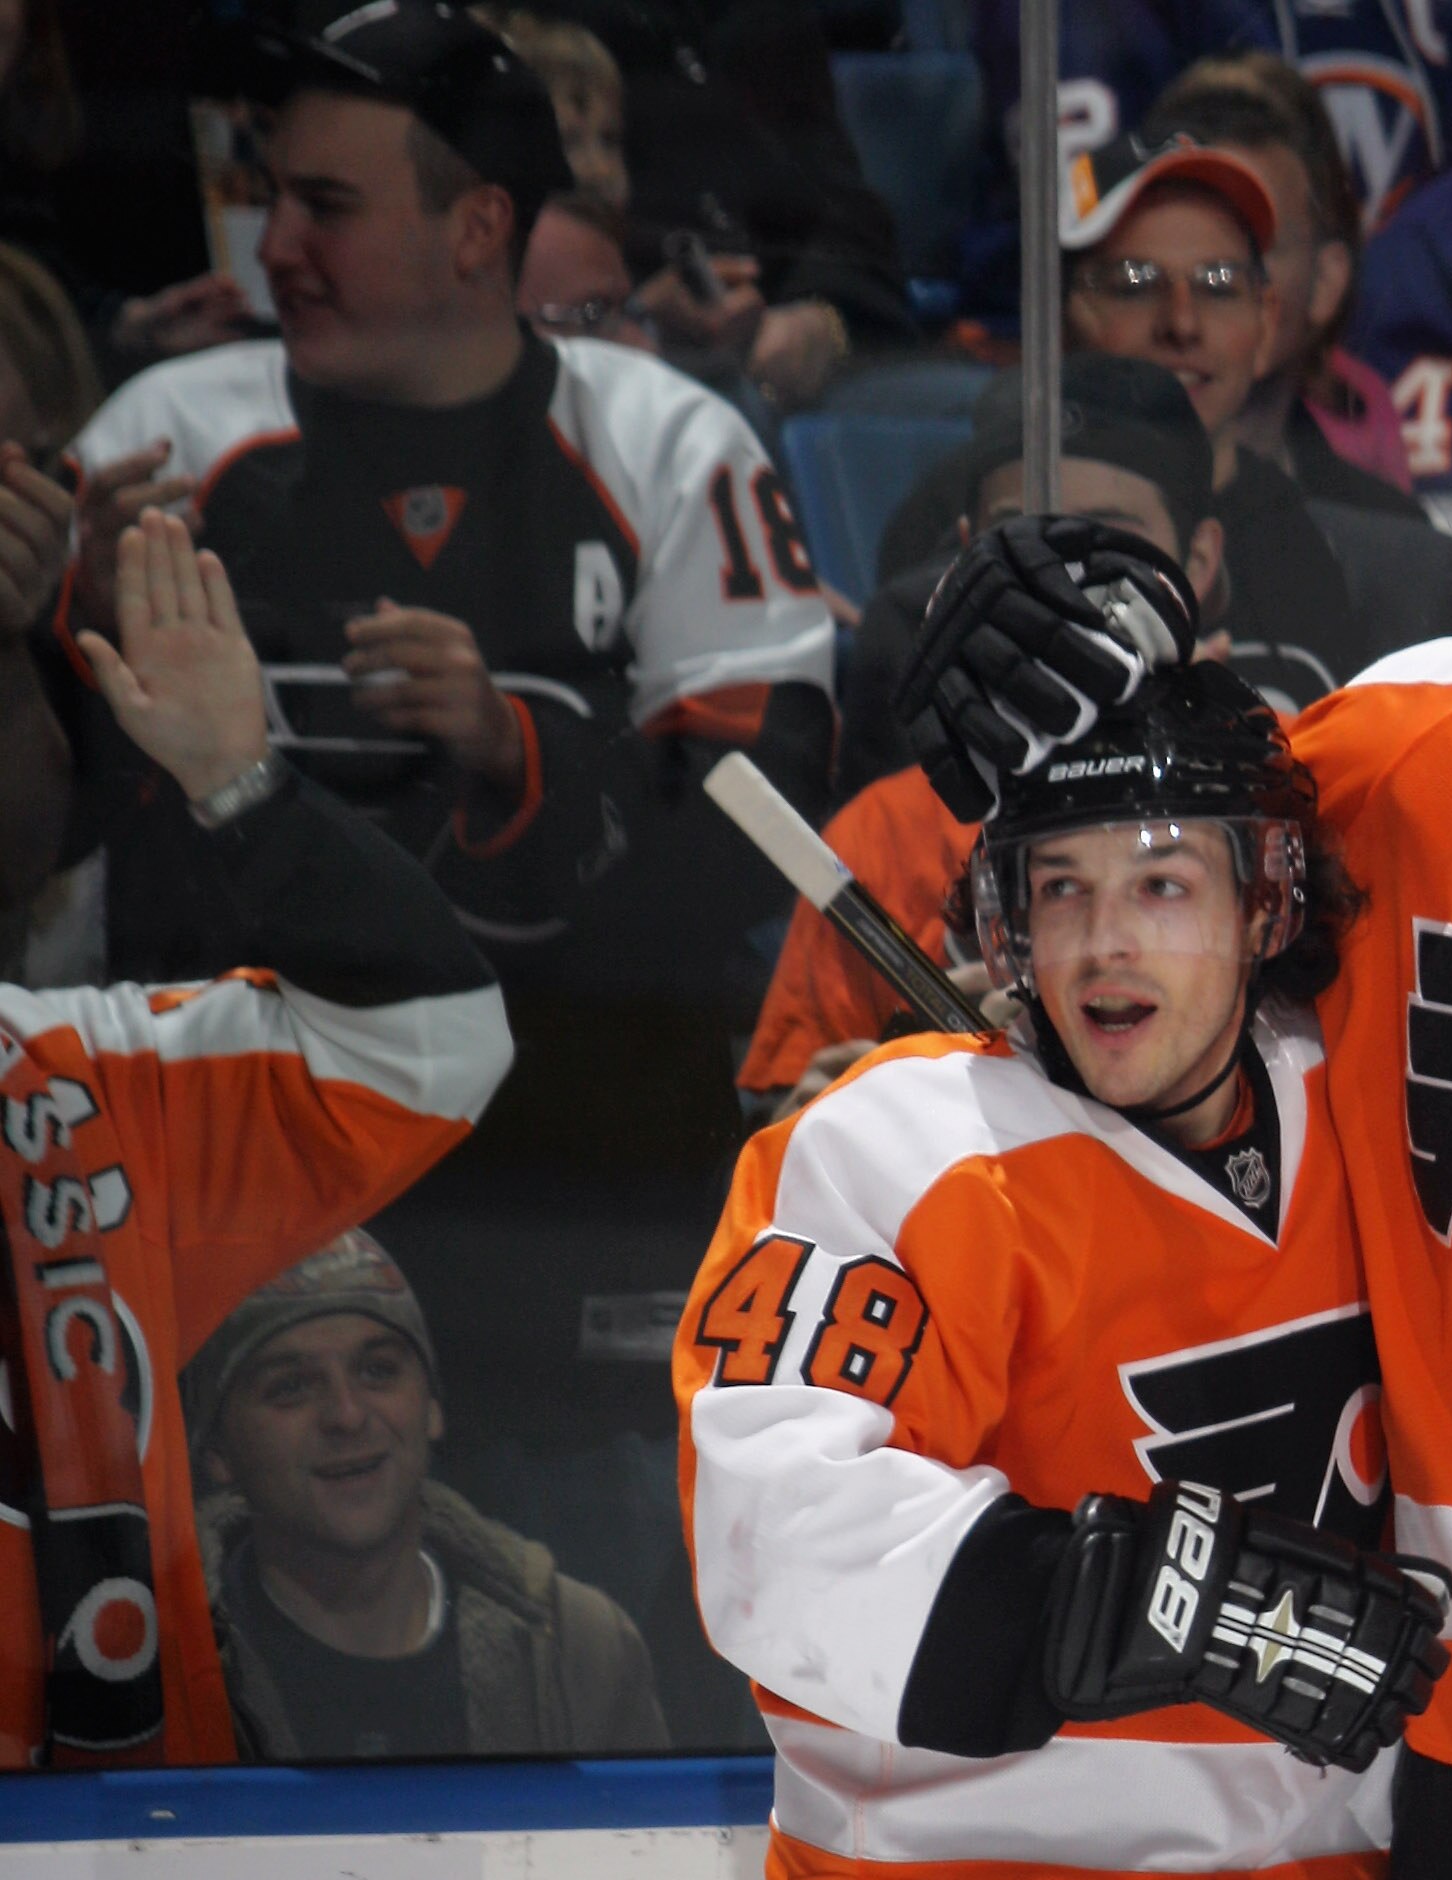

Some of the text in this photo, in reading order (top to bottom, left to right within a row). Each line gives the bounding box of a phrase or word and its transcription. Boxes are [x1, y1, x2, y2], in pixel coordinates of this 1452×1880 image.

[573, 541, 624, 653] A
[707, 463, 823, 605] 18
[1047, 755, 1145, 782] BAUER
[695, 1233, 930, 1408] 48
